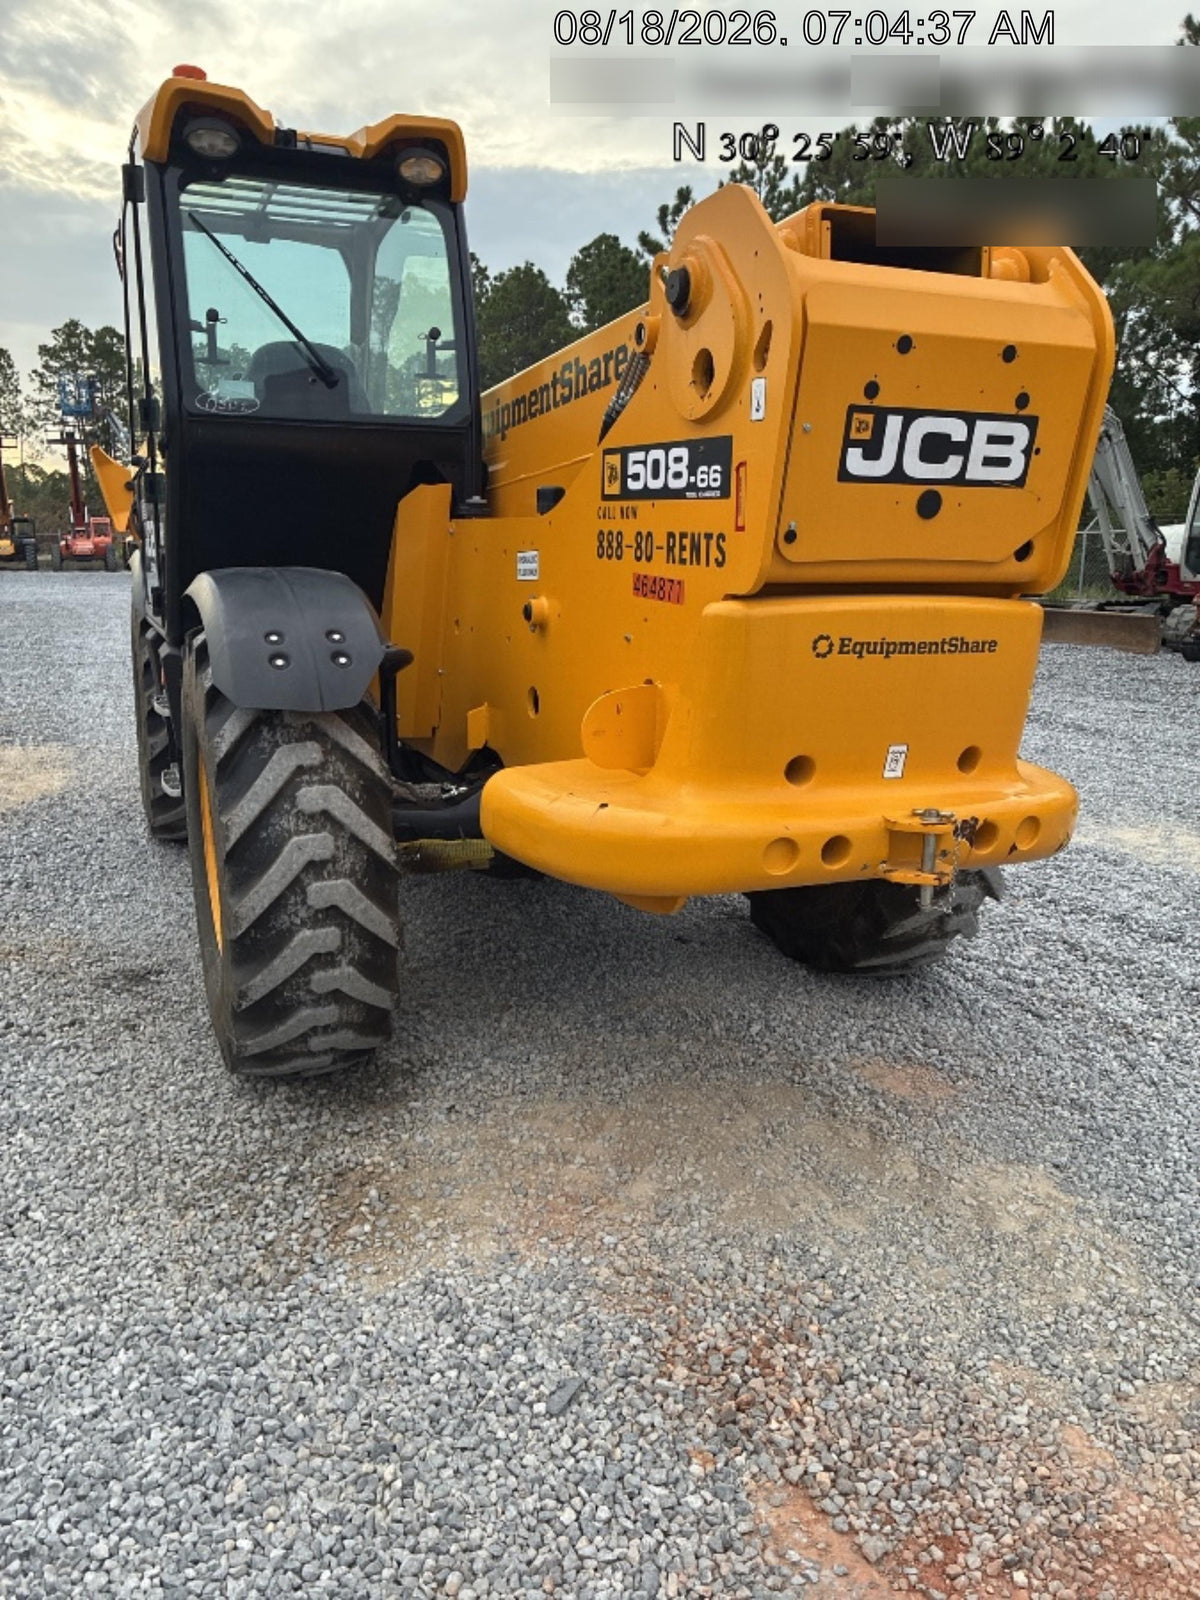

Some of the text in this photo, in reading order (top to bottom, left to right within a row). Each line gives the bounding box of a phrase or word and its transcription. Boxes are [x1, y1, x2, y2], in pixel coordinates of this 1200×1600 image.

[482, 343, 629, 441] uipmentShare
[846, 414, 1030, 481] JCB
[596, 529, 727, 568] 888-80-RENTS
[837, 636, 998, 659] EquipmentShare
